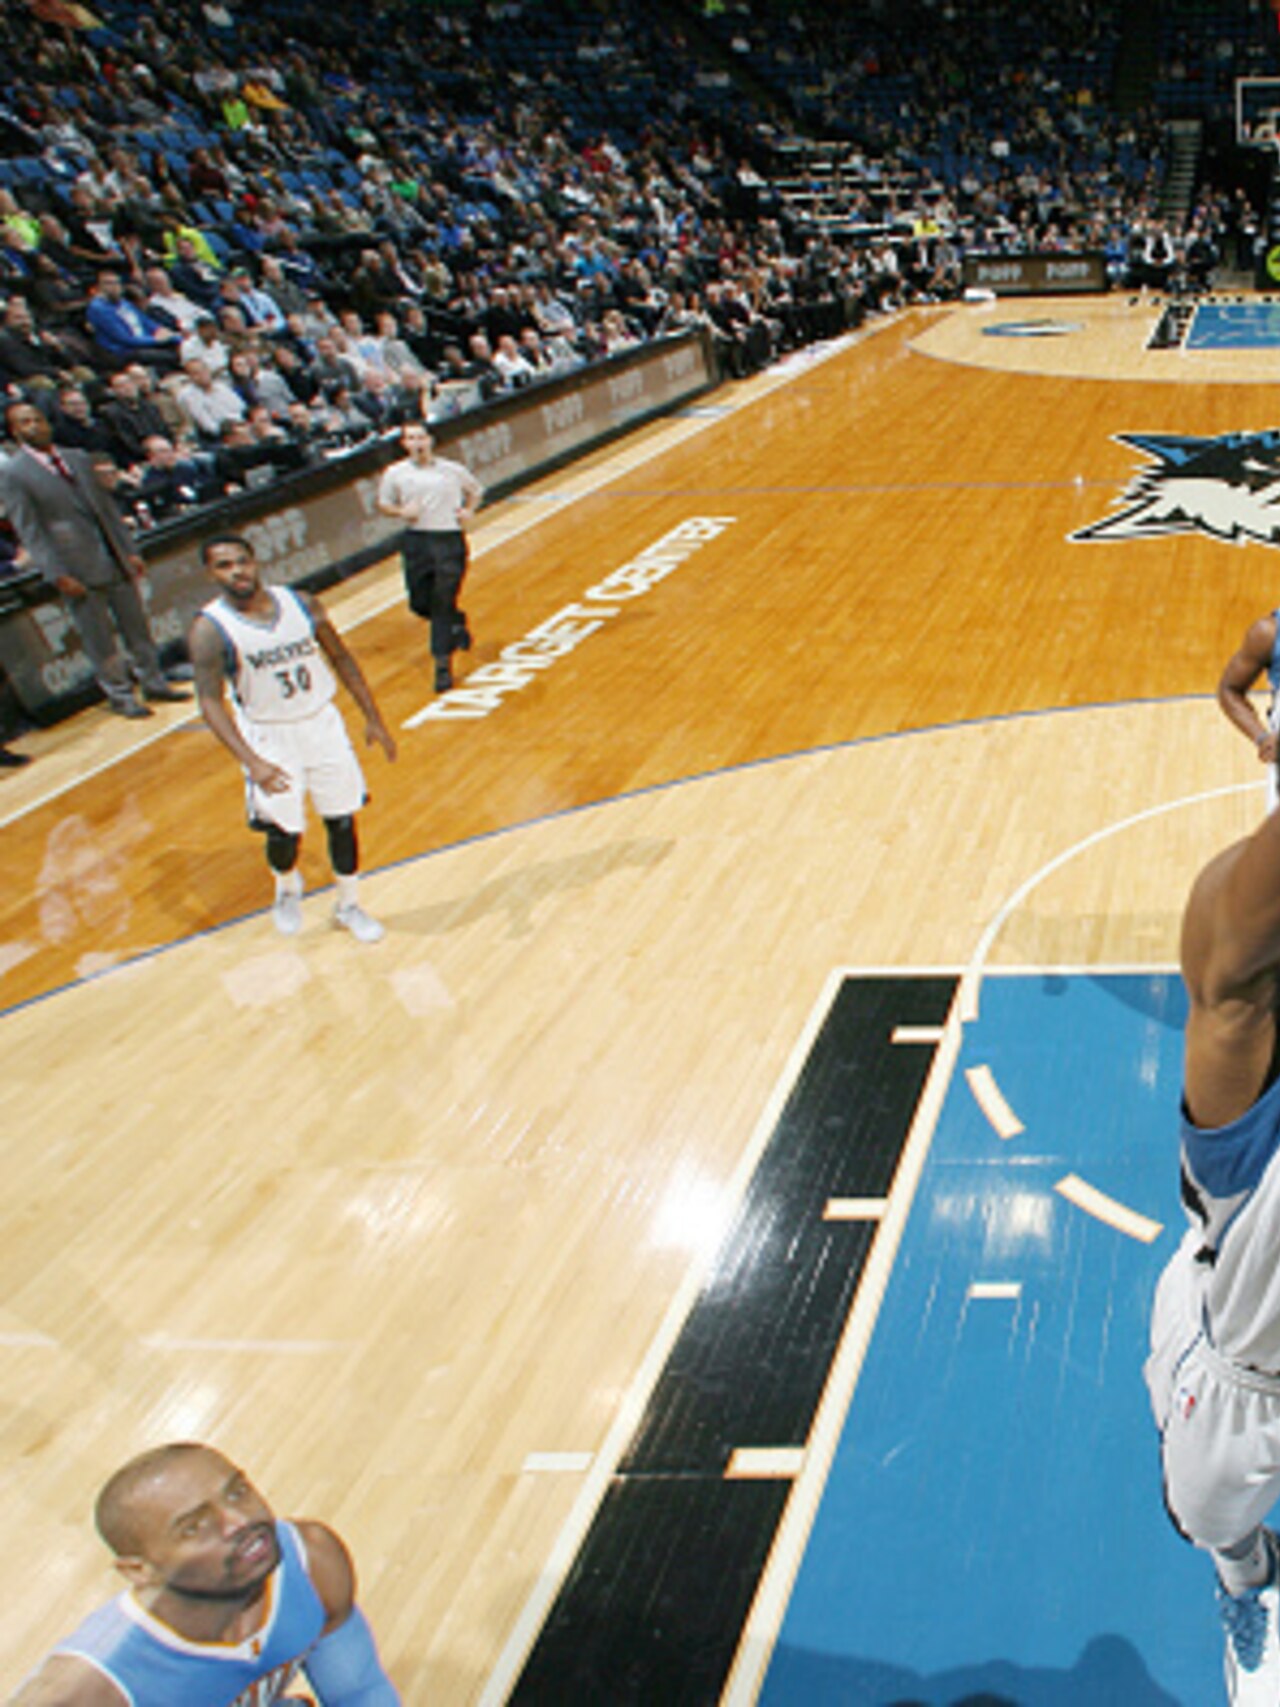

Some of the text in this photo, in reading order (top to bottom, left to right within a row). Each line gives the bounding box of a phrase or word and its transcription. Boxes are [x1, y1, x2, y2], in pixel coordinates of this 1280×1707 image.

[274, 664, 312, 699] 30
[401, 516, 738, 729] TARGET CENTER
